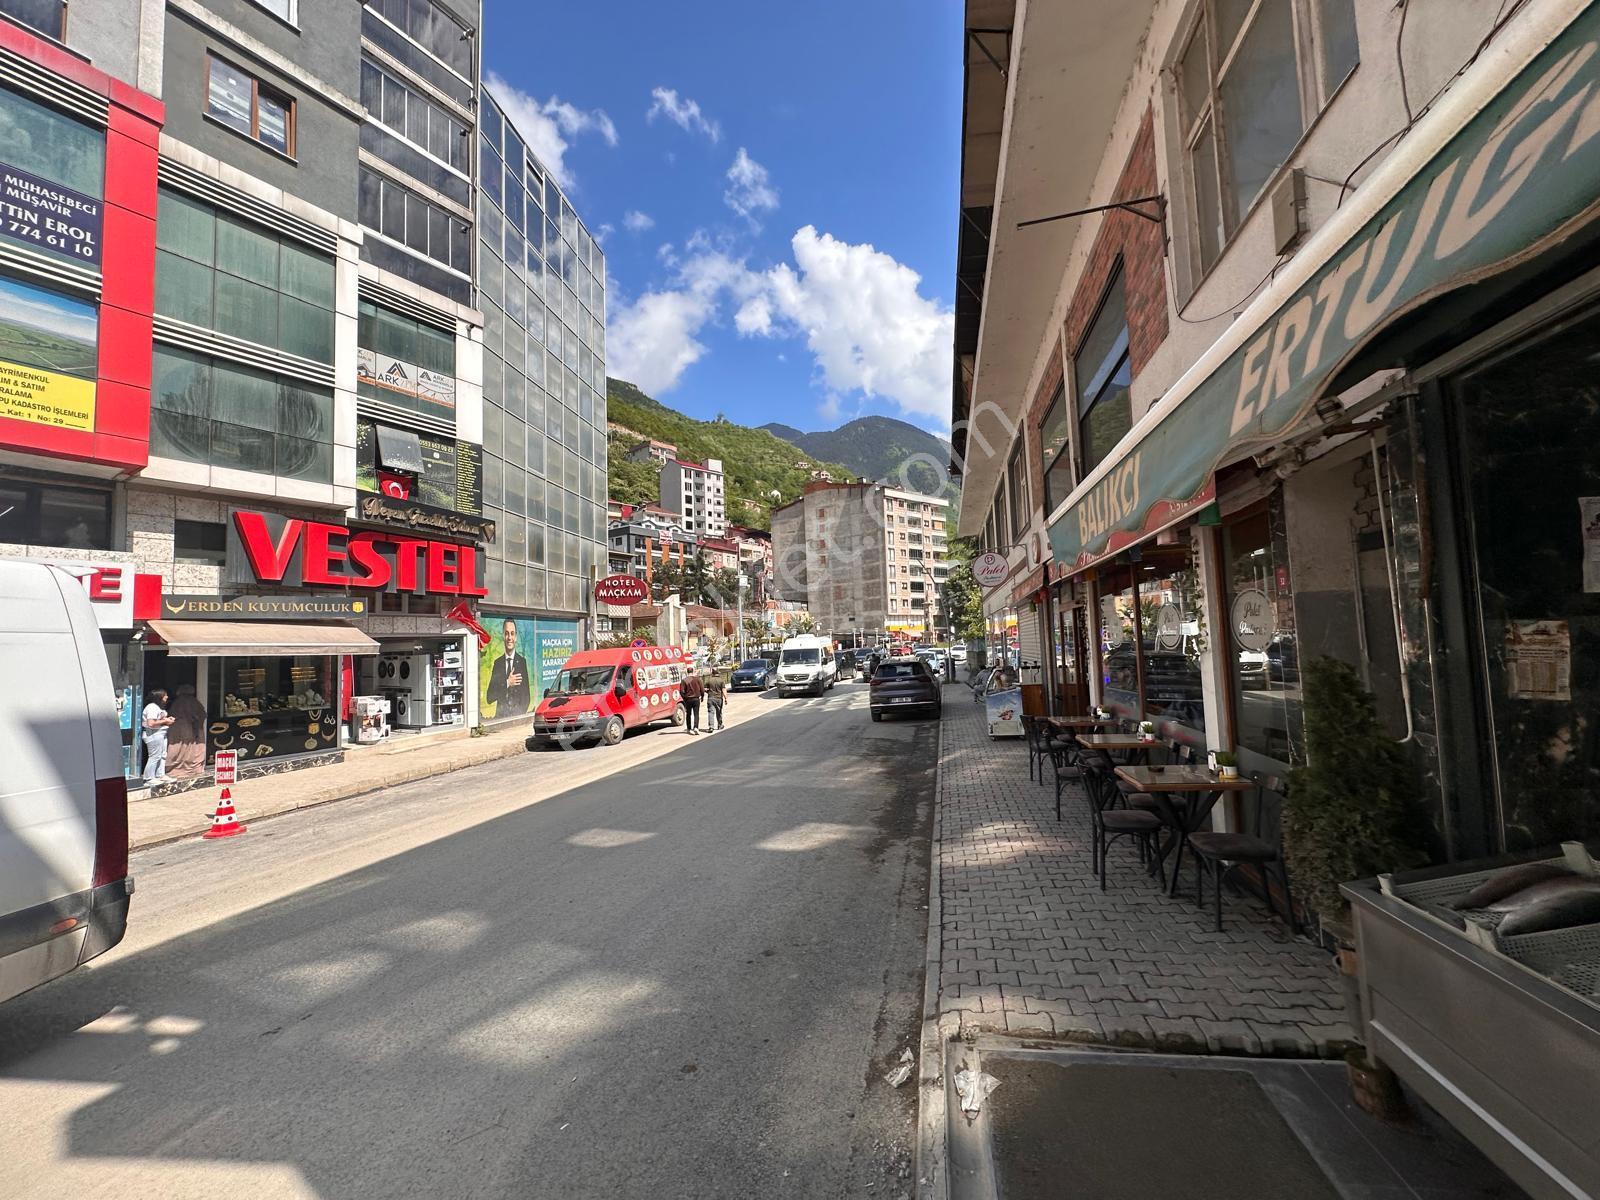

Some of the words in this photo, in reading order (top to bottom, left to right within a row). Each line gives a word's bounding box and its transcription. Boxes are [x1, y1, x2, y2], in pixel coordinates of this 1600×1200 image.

[5, 174, 97, 216] MUHASEBECİ
[6, 186, 72, 218] MÜŞAVİR
[9, 220, 41, 240] 774
[46, 235, 65, 248] 61
[75, 243, 93, 257] 10
[45, 217, 95, 245] EROL
[21, 381, 46, 392] SATIM
[377, 373, 400, 387] ARK
[12, 399, 51, 413] KADASTRO
[53, 406, 89, 420] İŞLEMLERİ
[233, 511, 489, 597] VESTEL
[599, 588, 642, 599] MAÇKAM
[188, 601, 243, 612] ERDEN
[248, 601, 350, 613] KUYUMCULUK
